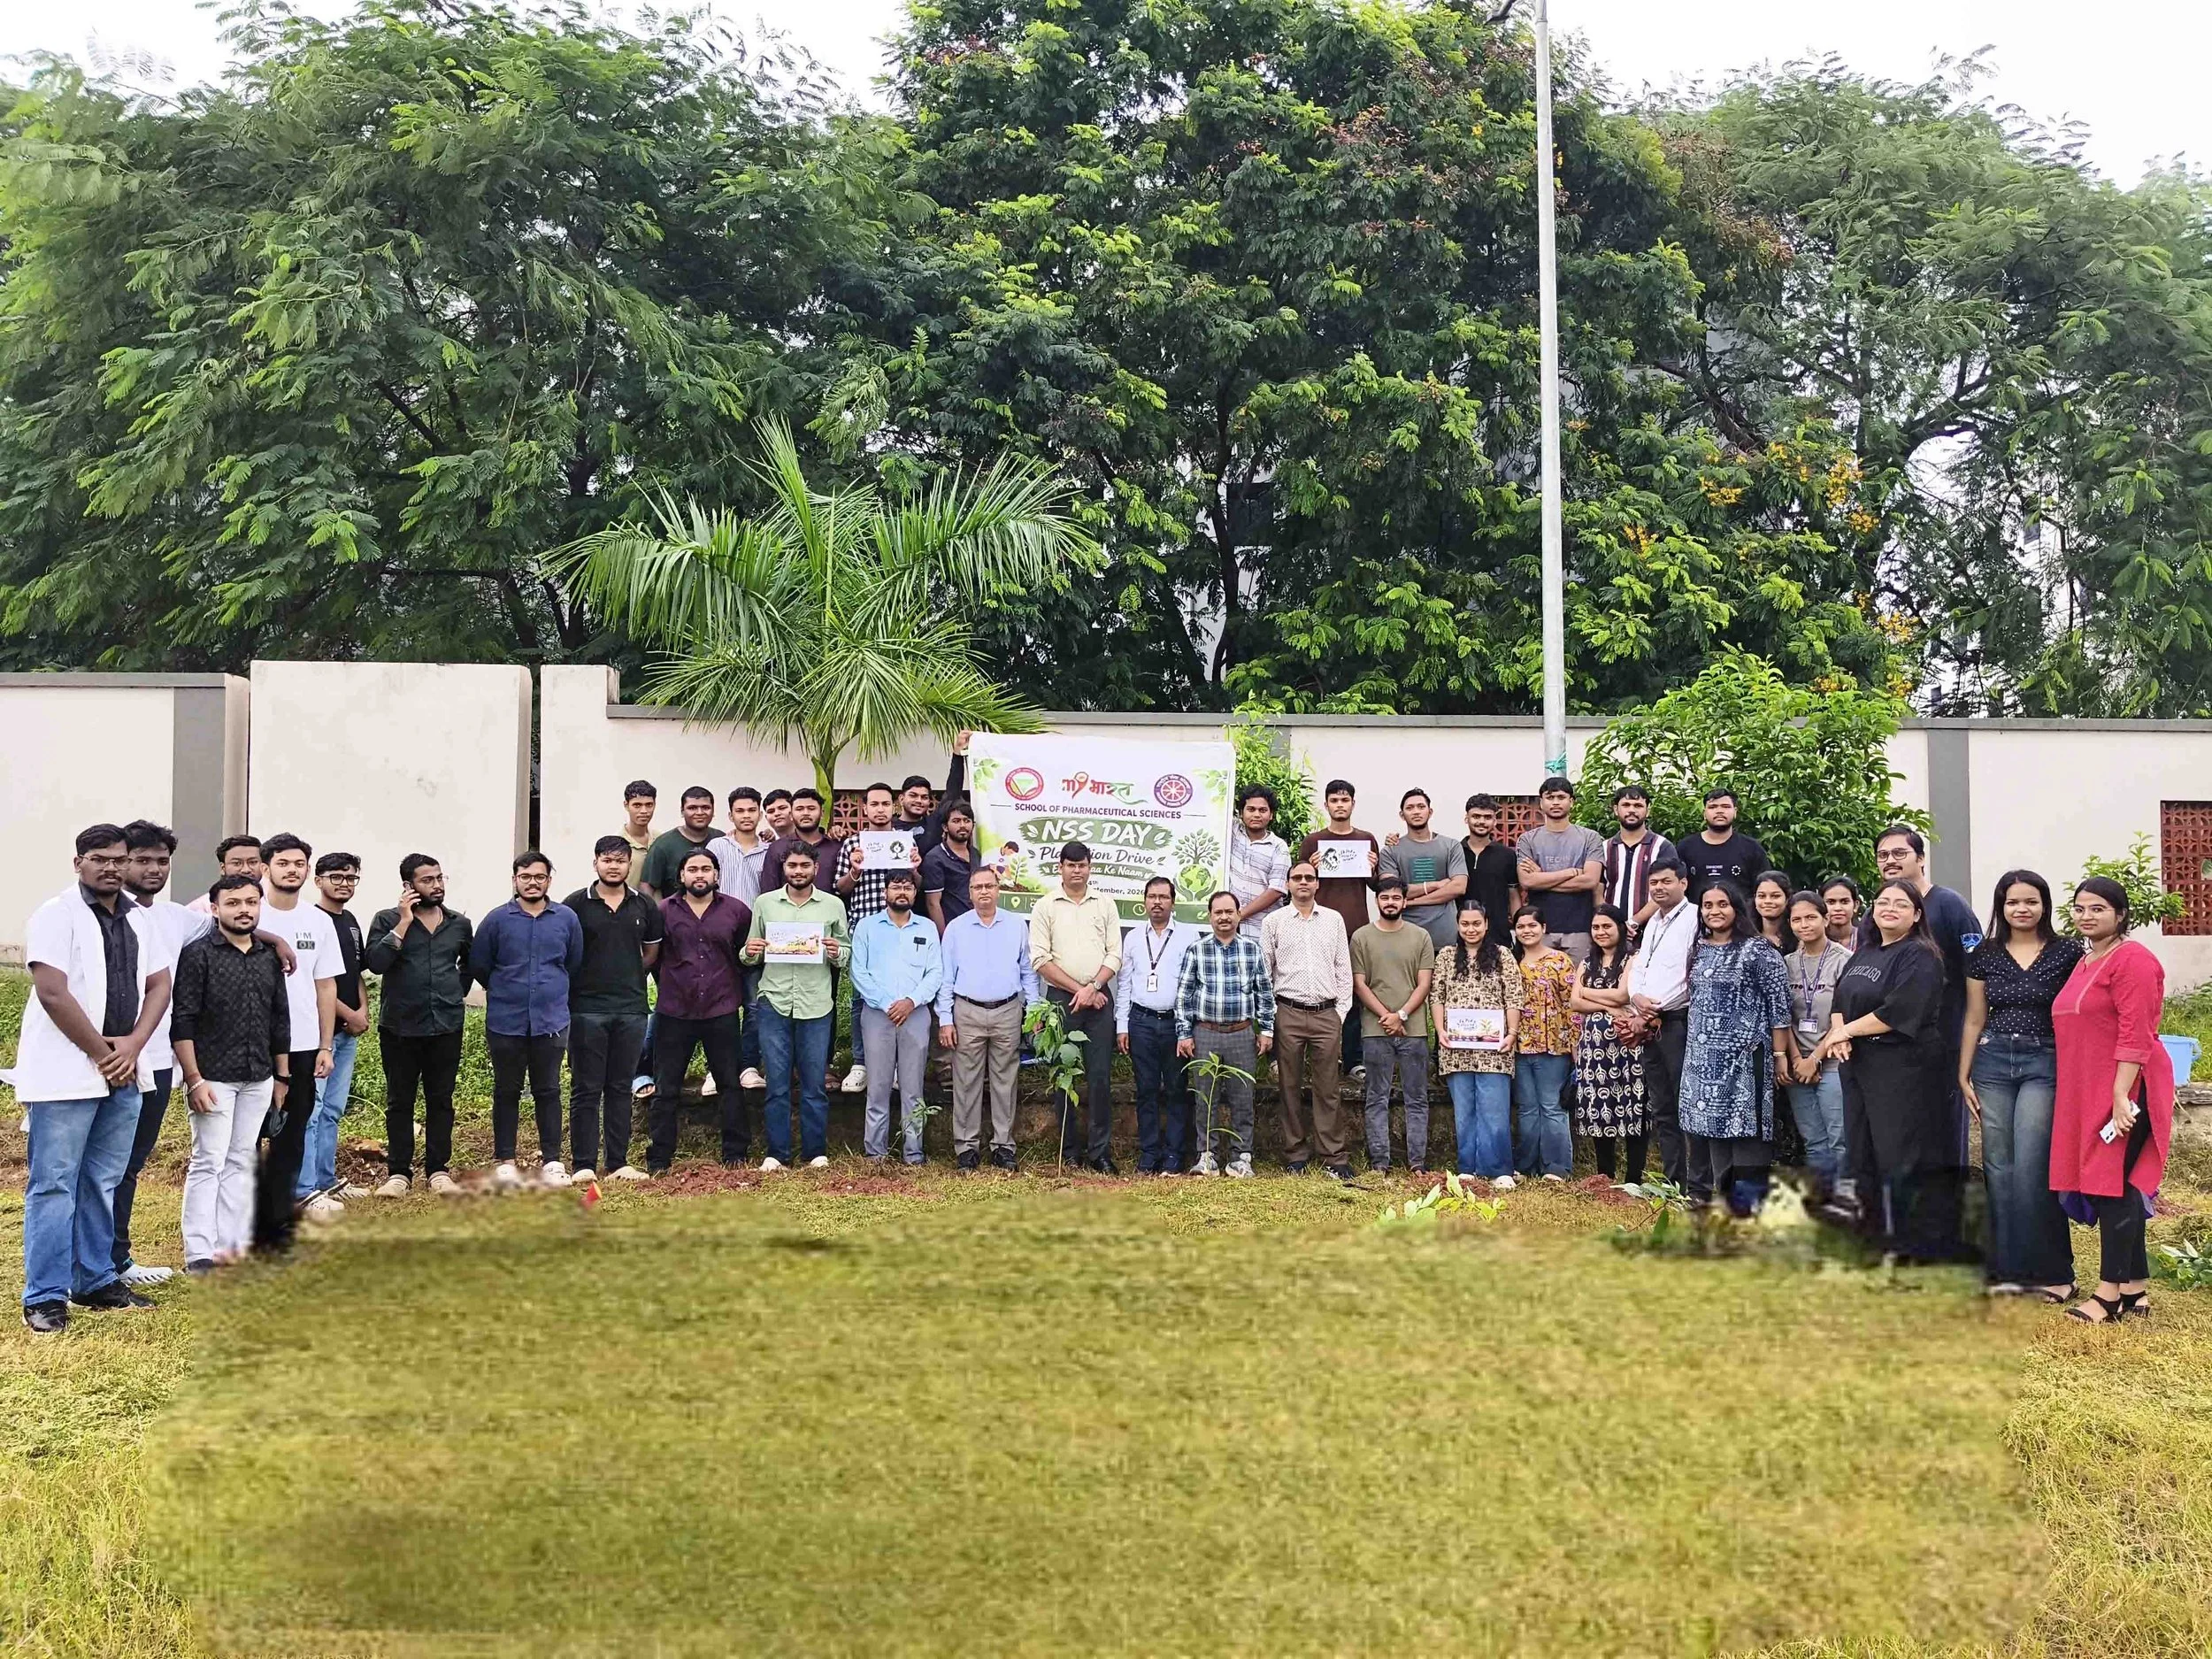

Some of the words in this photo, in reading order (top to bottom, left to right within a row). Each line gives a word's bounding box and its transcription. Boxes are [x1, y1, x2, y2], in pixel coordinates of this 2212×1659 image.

[1089, 780, 1147, 804] भारत
[1015, 803, 1048, 812] SCHOOL
[1063, 806, 1137, 817] PHARMACEUTICAL
[1140, 810, 1181, 819] SCIENCES
[1041, 819, 1094, 841] NSS
[1101, 822, 1153, 847] DAY
[1039, 846, 1112, 861] Plaion
[1114, 849, 1155, 864] Drive
[1103, 864, 1117, 875] Ke
[1118, 866, 1143, 878] Naam
[298, 941, 315, 949] OK
